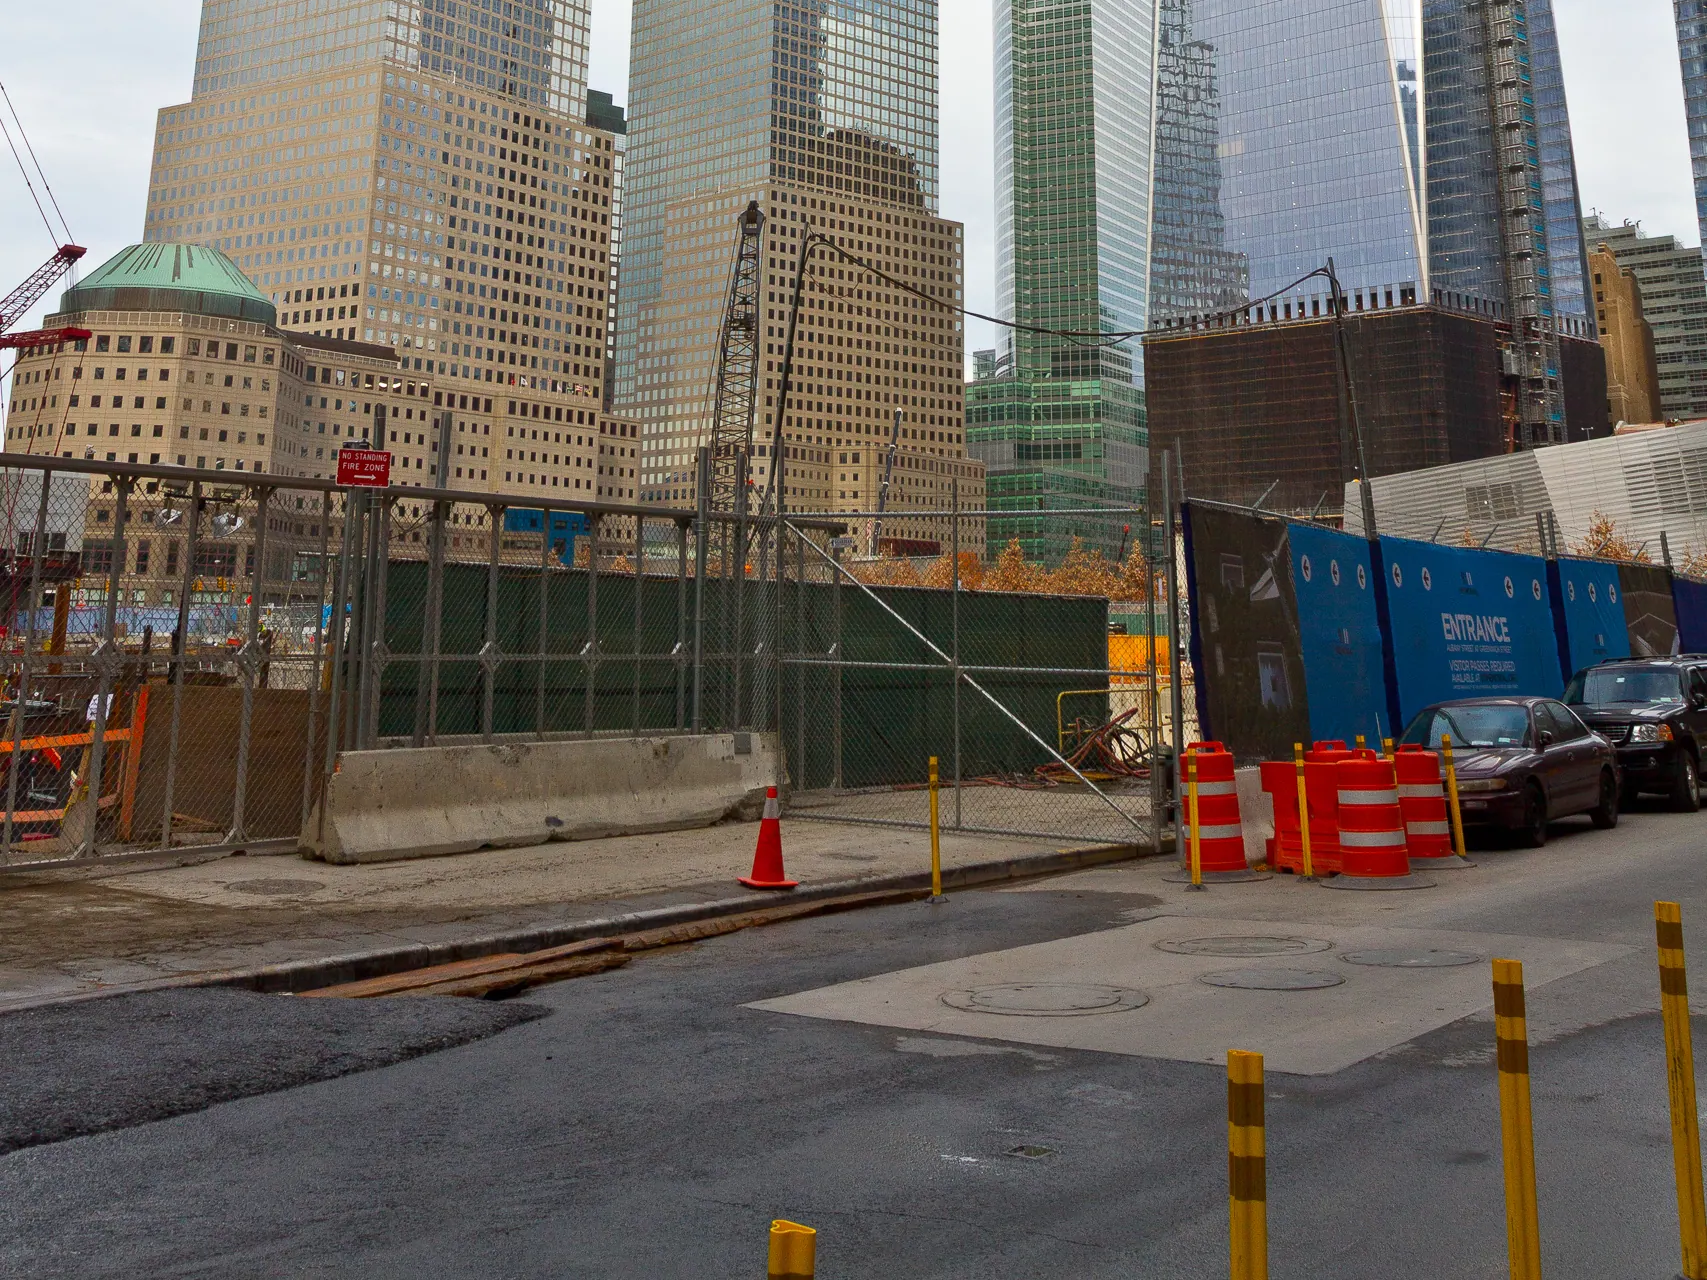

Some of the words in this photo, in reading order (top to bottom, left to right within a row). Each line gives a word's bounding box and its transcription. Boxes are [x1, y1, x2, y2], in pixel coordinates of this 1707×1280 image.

[342, 452, 352, 460] NO
[355, 453, 388, 462] STANDING
[342, 462, 360, 471] FIRE
[364, 463, 385, 472] ZONE
[1441, 613, 1511, 642] ENTRANCE
[1448, 659, 1470, 672] VISITOR
[1470, 660, 1490, 672] PASSES
[1490, 660, 1516, 672] REQUIRED
